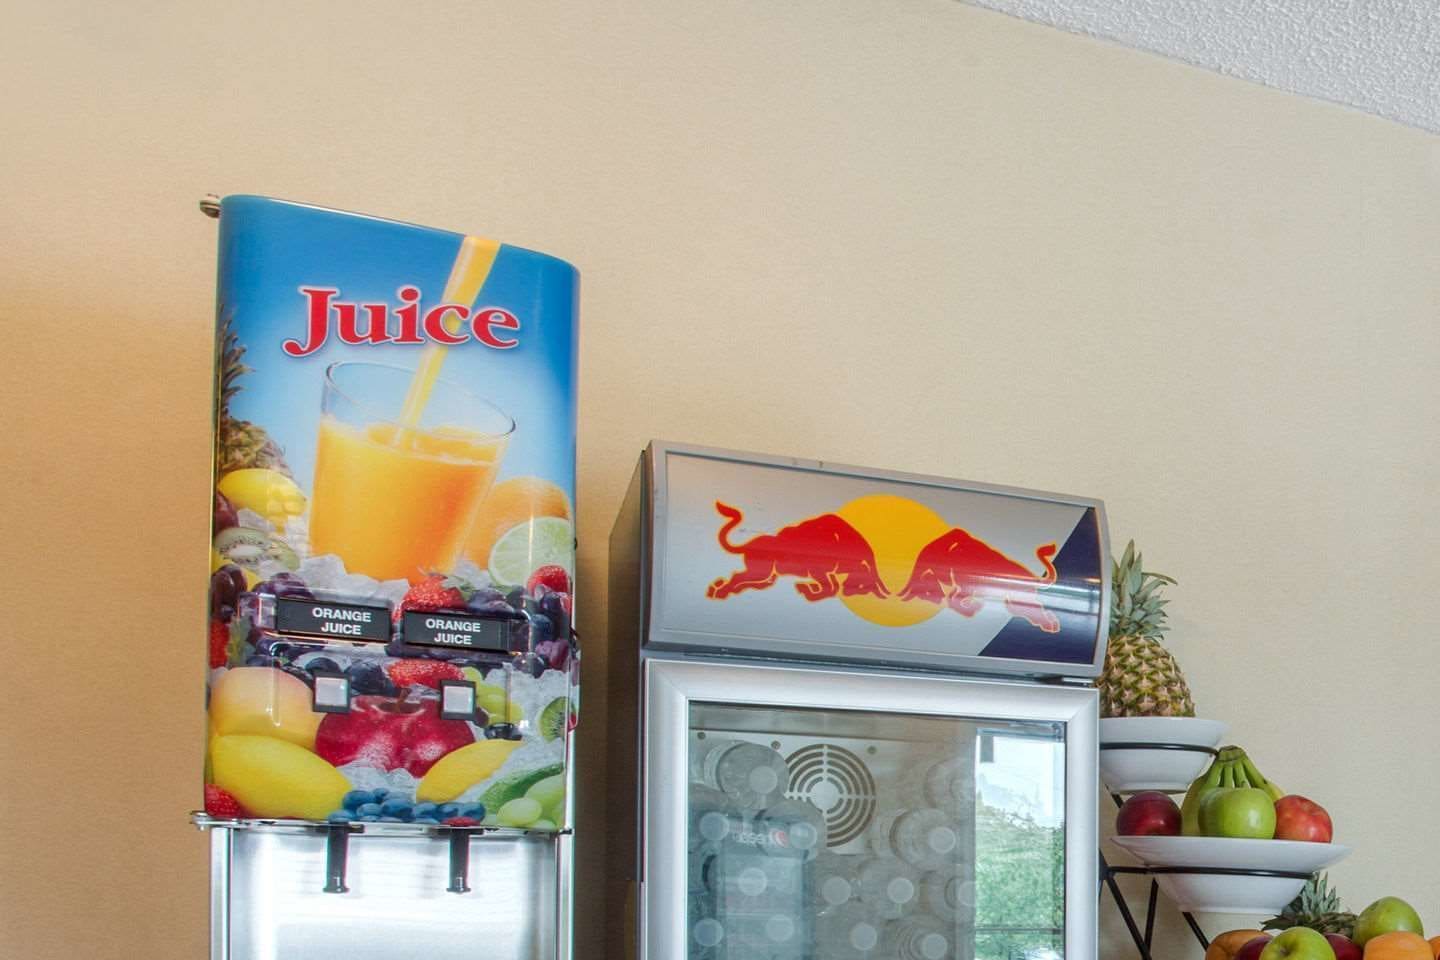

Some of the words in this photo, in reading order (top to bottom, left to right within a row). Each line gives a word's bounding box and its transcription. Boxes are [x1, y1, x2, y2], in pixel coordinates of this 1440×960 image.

[282, 285, 521, 358] Juice
[312, 606, 372, 623] ORANGE
[320, 621, 362, 636] JUICE
[425, 618, 481, 633] ORANGE
[433, 632, 473, 645] JUICE
